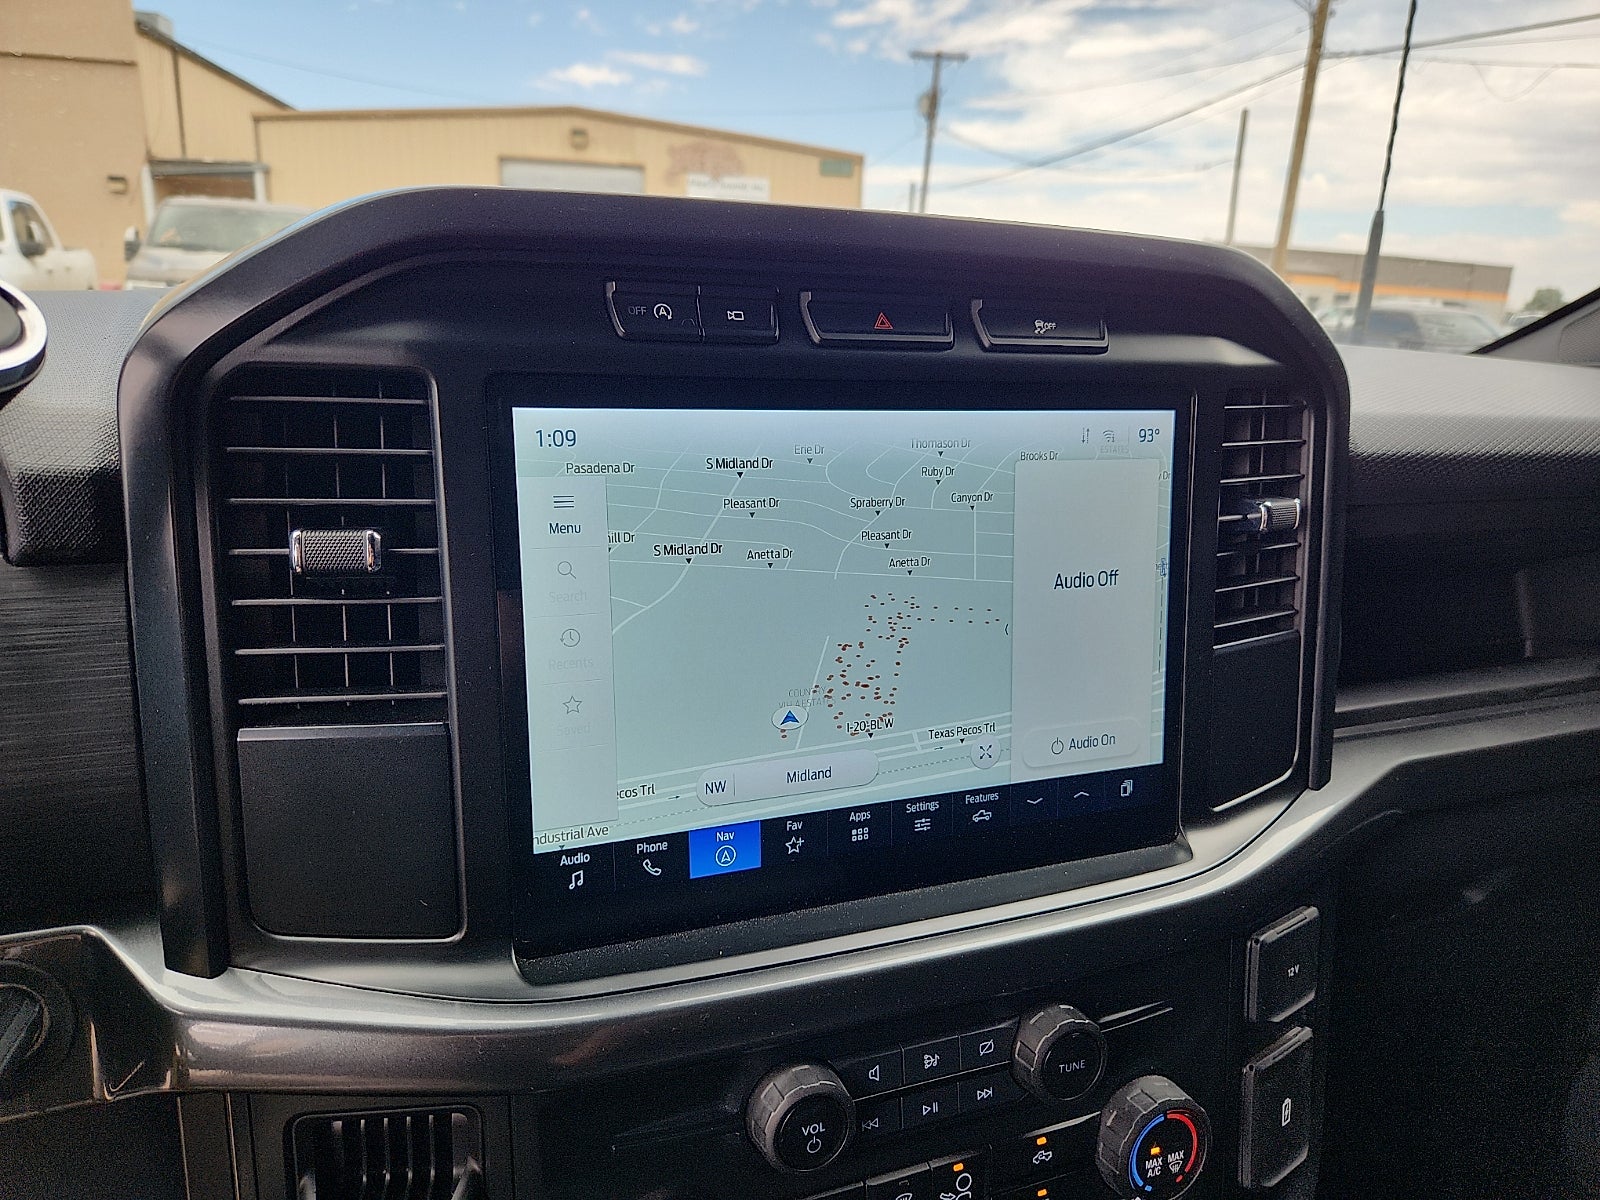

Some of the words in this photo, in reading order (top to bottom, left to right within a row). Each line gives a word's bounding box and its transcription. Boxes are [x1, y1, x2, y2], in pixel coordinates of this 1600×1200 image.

[628, 305, 647, 316] OFF
[1043, 322, 1057, 331] OFF
[535, 428, 577, 448] 1:09
[911, 438, 956, 450] Thomason
[957, 437, 971, 449] Dr
[793, 445, 812, 456] Erie
[814, 445, 826, 455] Dr
[1019, 450, 1049, 462] Brooks
[565, 462, 619, 474] Pasadena
[620, 462, 635, 474] Dr
[705, 457, 713, 470] S
[716, 457, 759, 470] Midland
[760, 456, 774, 470] Dr
[920, 465, 943, 479] Ruby
[944, 464, 956, 476] Dr
[723, 497, 767, 510] Pleasant
[768, 497, 781, 509] Dr
[850, 497, 892, 510] Spraberry
[893, 496, 906, 508] Dr
[951, 492, 982, 506] Canyon
[983, 492, 994, 503] Dr
[548, 522, 582, 536] Menu
[860, 530, 900, 542] Pleasant
[901, 529, 913, 541] Dr
[623, 531, 636, 543] Dr
[653, 544, 662, 557] S
[663, 543, 708, 556] Midland
[709, 542, 724, 556] Dr
[747, 548, 780, 561] Anetta
[780, 547, 794, 559] Dr
[888, 557, 918, 568] Anetta
[918, 556, 931, 567] Dr
[1053, 571, 1094, 590] Audio
[1097, 570, 1120, 588] Off
[882, 717, 895, 730] W
[928, 729, 954, 741] Texas
[955, 726, 982, 739] Pecos
[983, 722, 996, 736] Trl
[1068, 736, 1098, 751] Audio
[1100, 734, 1116, 747] On
[786, 766, 832, 784] Midland
[639, 783, 656, 796] Trl
[704, 780, 727, 795] NW
[965, 791, 999, 806] Features
[906, 799, 939, 815] Settings
[849, 809, 871, 822] Apps
[586, 825, 609, 838] Ave
[786, 819, 803, 832] Fav
[716, 831, 735, 843] Nav
[636, 839, 668, 855] Phone
[559, 852, 591, 867] Audio
[1058, 1059, 1086, 1075] TUNE
[801, 1122, 826, 1136] VOL
[1167, 1150, 1184, 1163] MAX
[1145, 1157, 1163, 1170] MAX
[1147, 1167, 1161, 1178] A/C
